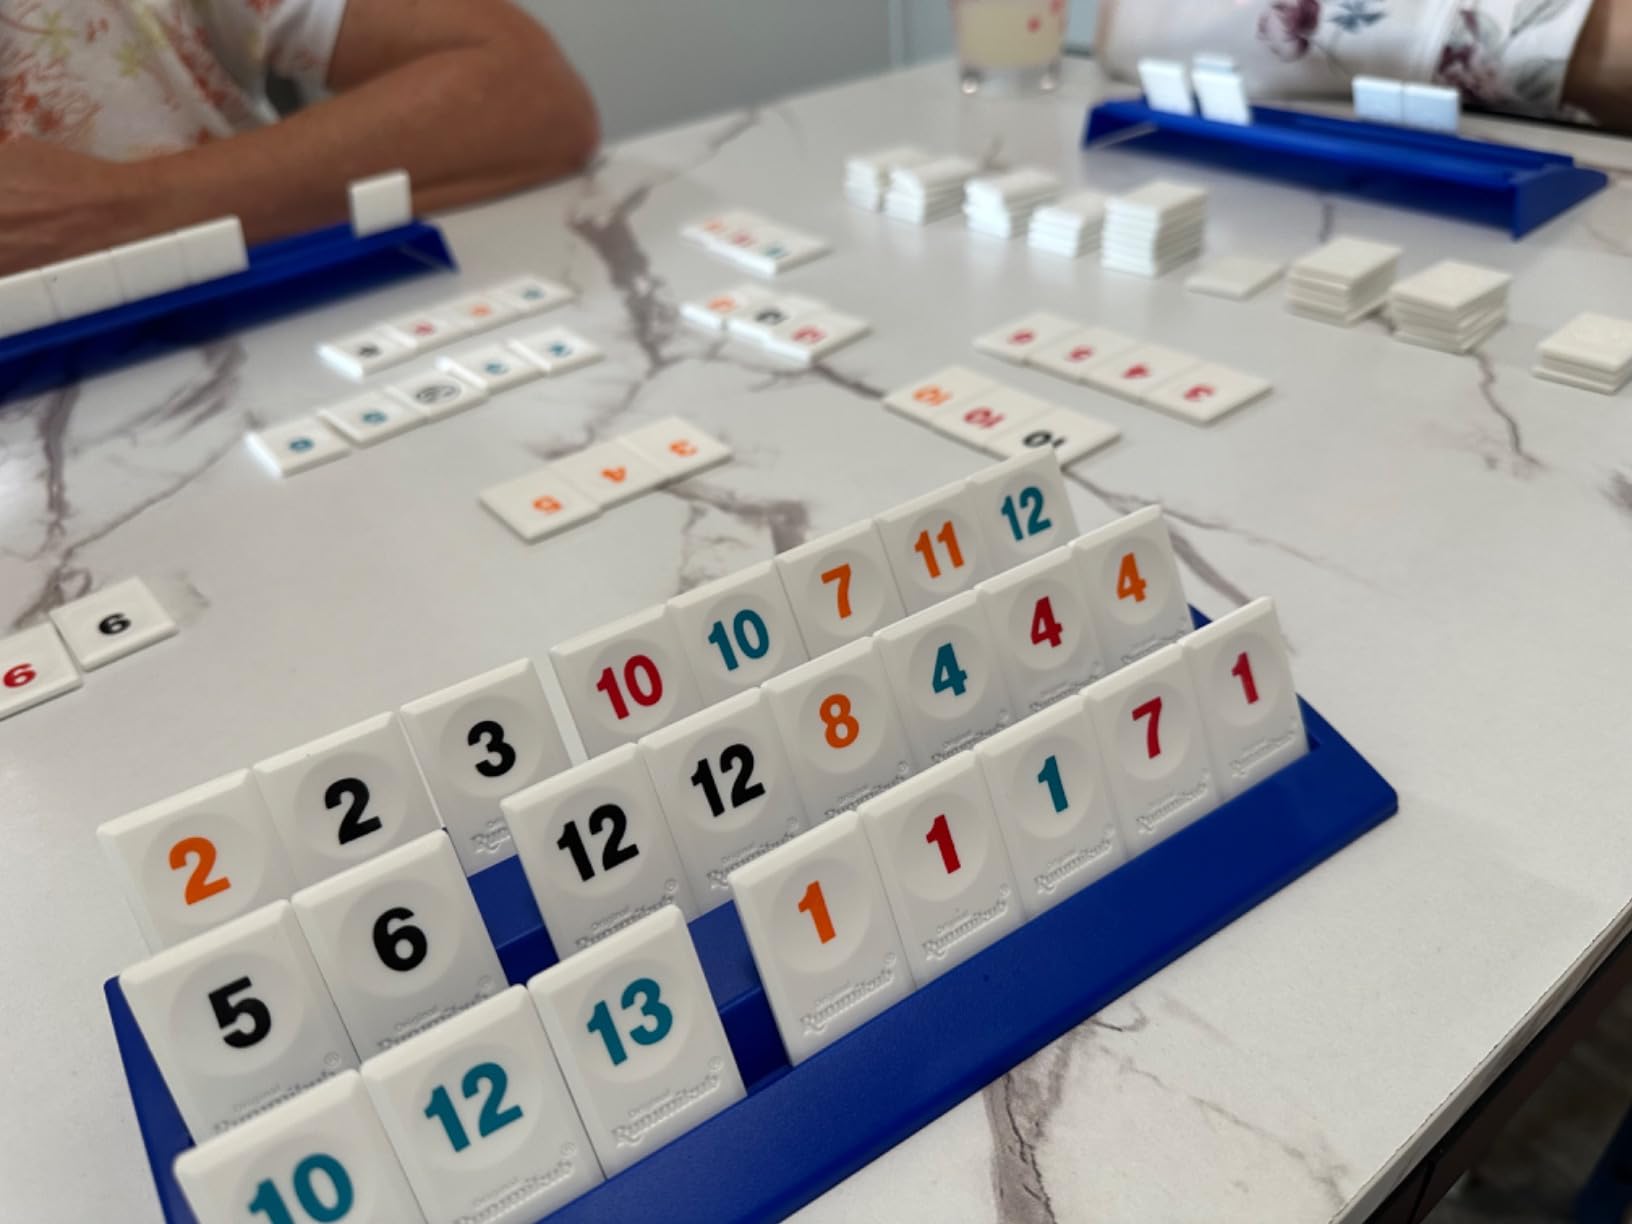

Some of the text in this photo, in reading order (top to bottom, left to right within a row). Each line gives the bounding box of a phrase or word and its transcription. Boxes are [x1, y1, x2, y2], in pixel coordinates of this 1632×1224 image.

[1001, 487, 1051, 540] 12
[915, 521, 964, 577] 11
[1117, 553, 1147, 602] 4
[821, 564, 852, 618] 7
[98, 613, 131, 635] 6
[708, 609, 769, 671] 10
[1031, 597, 1063, 648] 4
[3, 663, 36, 688] 6
[597, 655, 662, 719] 10
[932, 643, 967, 697] 4
[1232, 652, 1258, 703] 1
[468, 720, 516, 778] 3
[820, 694, 860, 748] 8
[1132, 697, 1163, 758] 7
[691, 744, 765, 817] 12
[1038, 755, 1069, 812] 1
[325, 777, 383, 845] 2
[169, 837, 230, 906] 2
[557, 804, 639, 881] 12
[926, 815, 960, 875] 1
[373, 906, 428, 972] 6
[799, 881, 836, 945] 1
[208, 976, 272, 1048] 5
[587, 977, 672, 1065] 13
[424, 1062, 523, 1152] 12
[248, 1153, 354, 1224] 10
